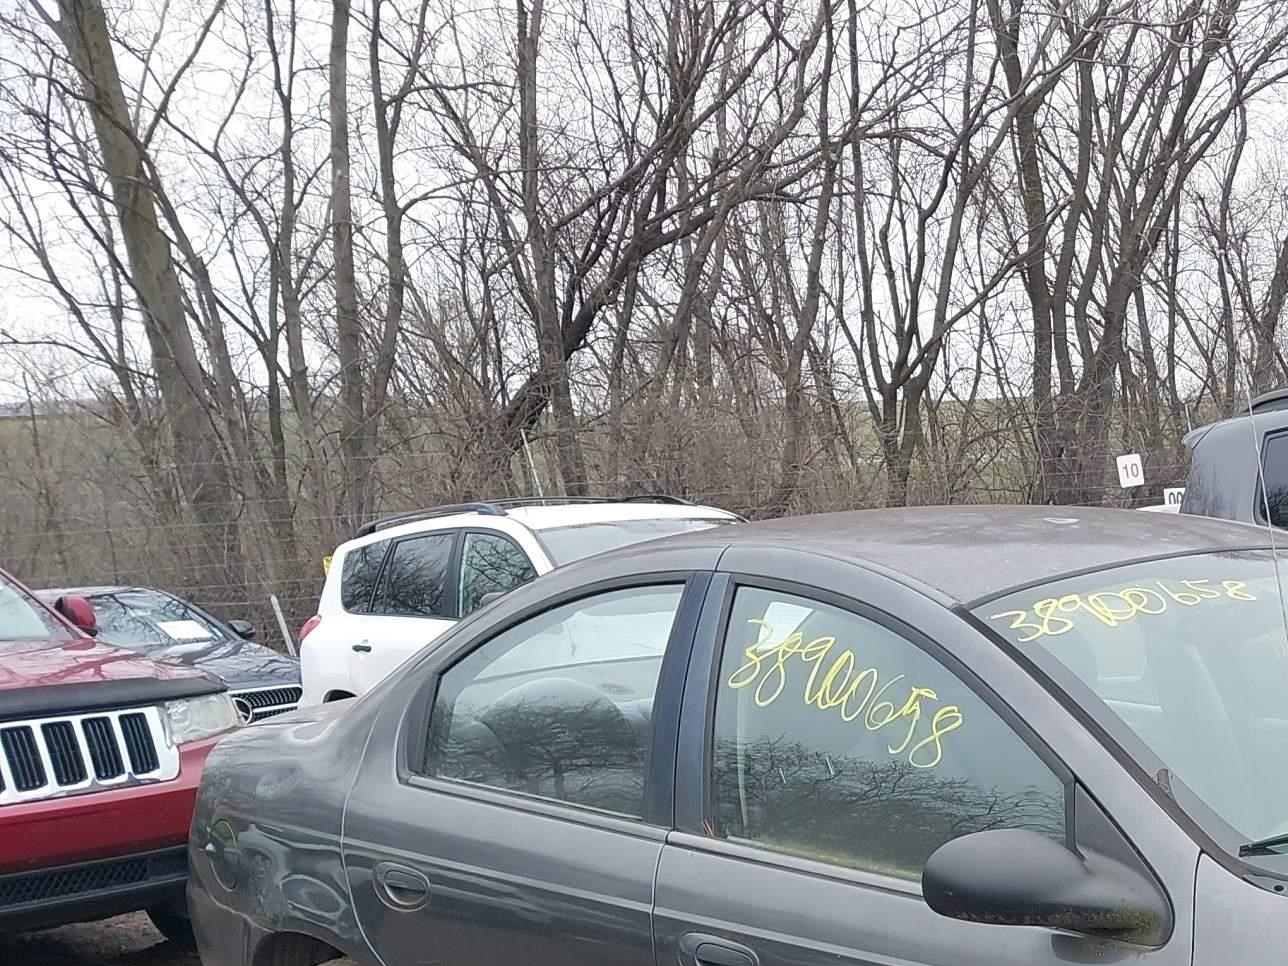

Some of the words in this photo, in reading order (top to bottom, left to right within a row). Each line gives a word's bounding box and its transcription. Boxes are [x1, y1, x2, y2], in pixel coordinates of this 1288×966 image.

[1122, 463, 1140, 479] 10
[990, 578, 1257, 642] 38900658
[727, 618, 963, 769] 38900658
